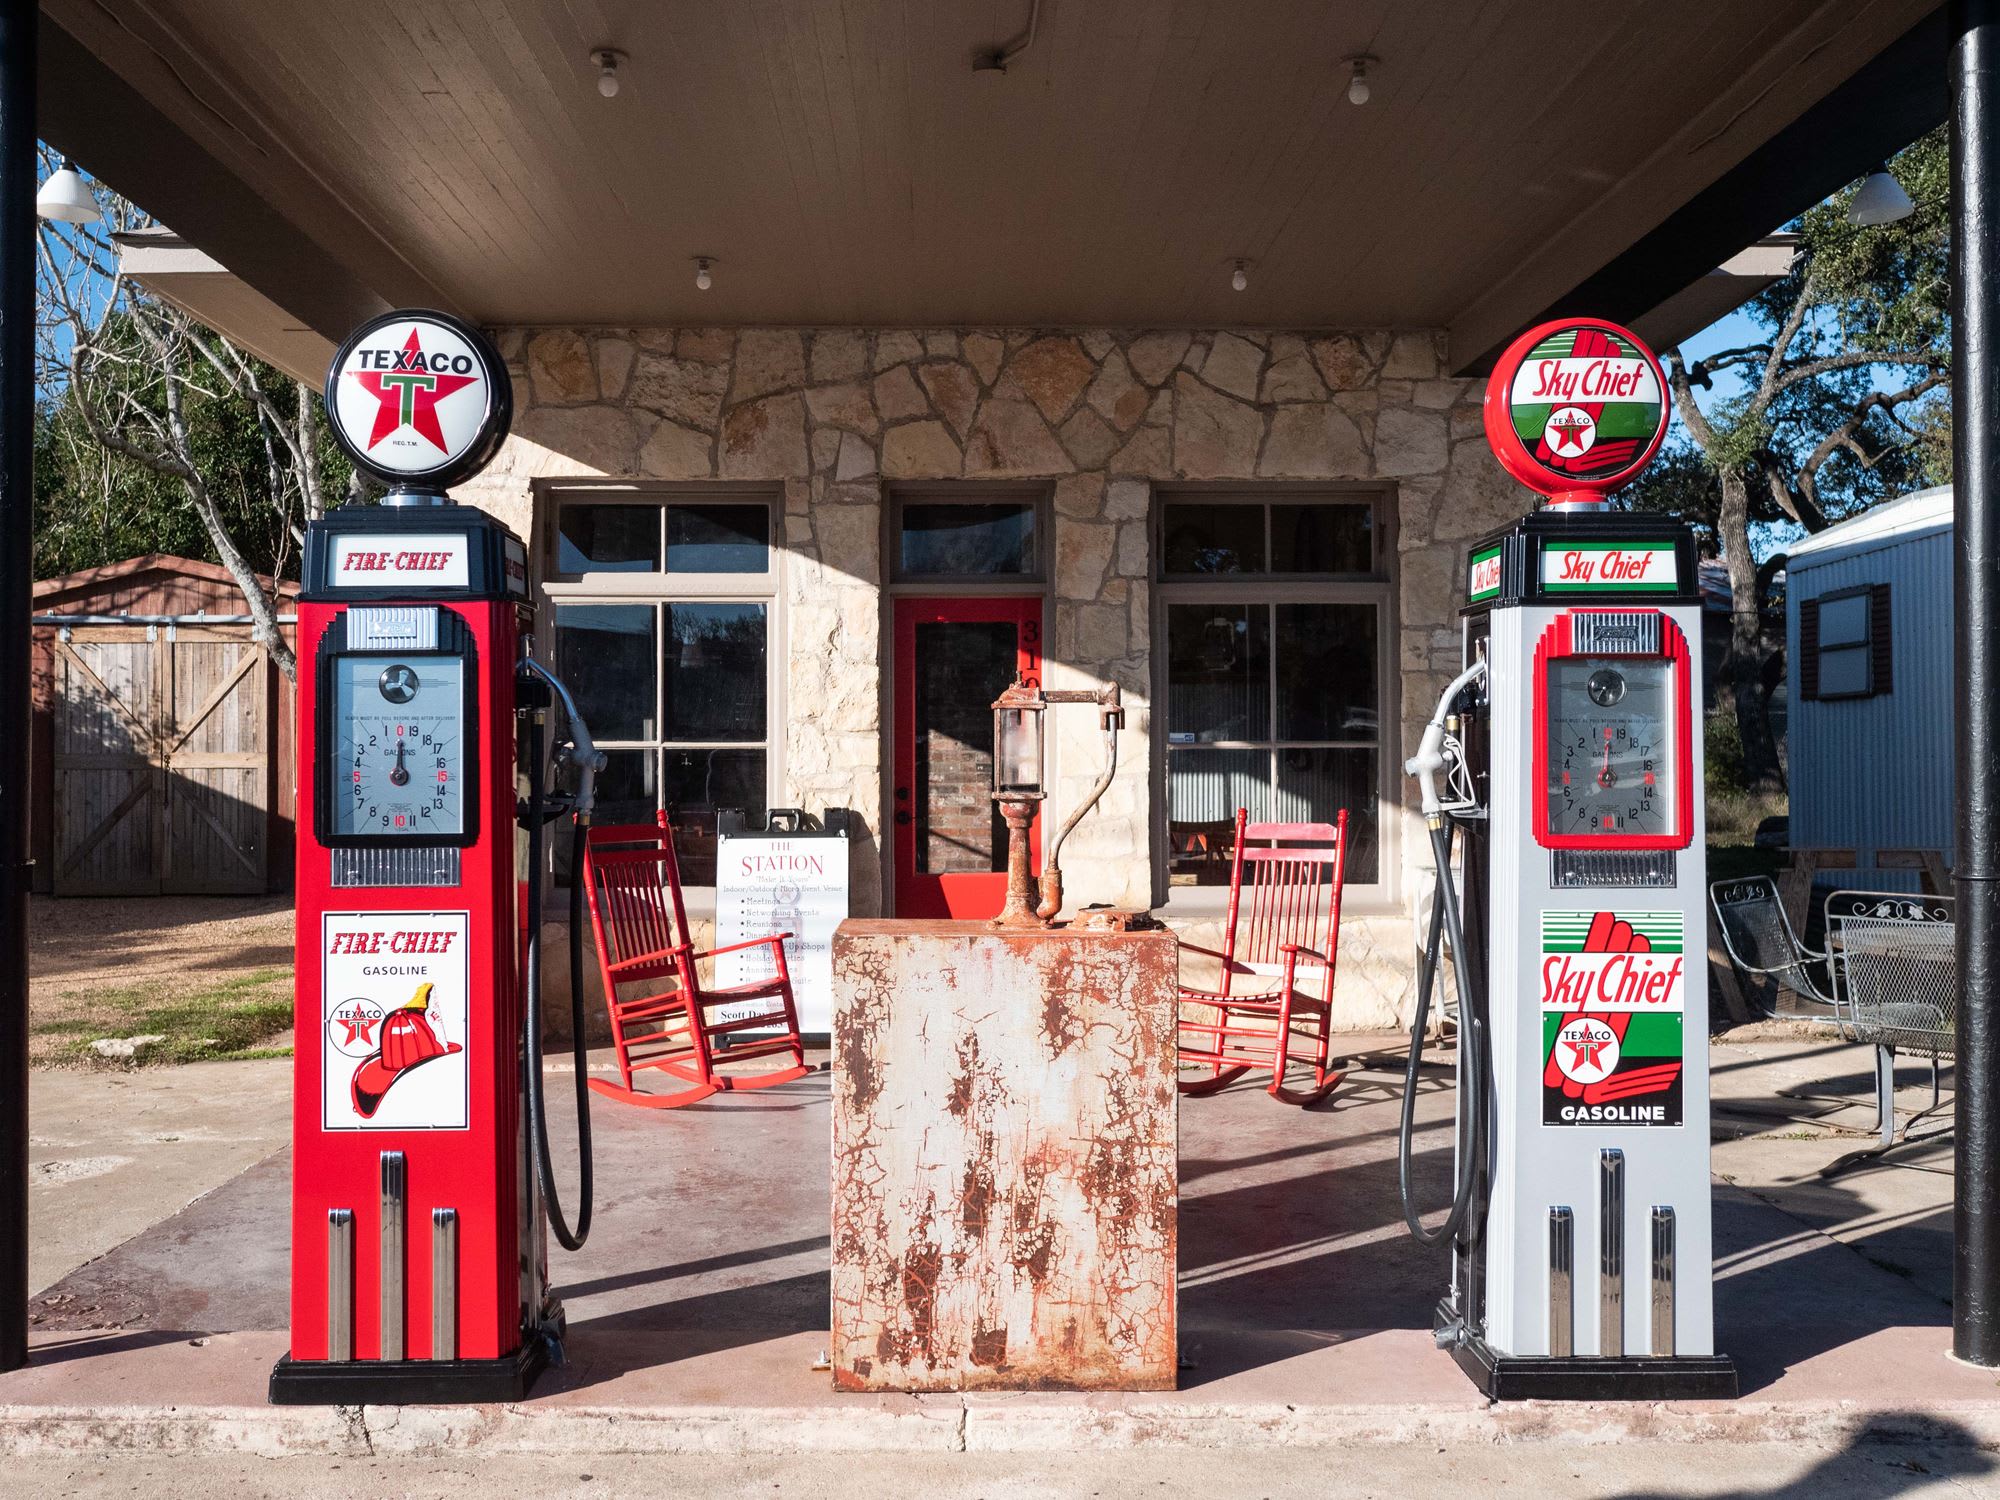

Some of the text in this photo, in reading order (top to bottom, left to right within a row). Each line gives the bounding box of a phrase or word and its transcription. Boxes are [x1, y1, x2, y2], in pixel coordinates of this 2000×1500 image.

[359, 350, 473, 374] TEXACO
[1532, 360, 1645, 400] Sky Chief
[381, 374, 436, 427] T
[1553, 417, 1590, 425] TEXACO
[1560, 425, 1581, 443] T
[343, 552, 453, 571] FIRE-CHIEF
[1559, 551, 1653, 583] Sky Chief
[1486, 559, 1500, 587] Chie
[384, 725, 388, 737] 1
[396, 725, 404, 736] 0
[409, 725, 419, 737] 19
[1593, 727, 1596, 739] 1
[1616, 728, 1626, 739] 19
[369, 735, 377, 746] 2
[422, 734, 432, 746] 18
[1578, 738, 1585, 748] 2
[1629, 737, 1639, 748] 18
[357, 744, 365, 755] 3
[433, 743, 443, 754] 17
[1567, 746, 1574, 757] 3
[1640, 746, 1650, 756] 17
[354, 757, 361, 769] 4
[436, 757, 446, 769] 16
[1564, 759, 1570, 770] 4
[1643, 760, 1653, 771] 16
[353, 771, 360, 782] 5
[437, 771, 448, 782] 15
[354, 785, 361, 796] 6
[436, 785, 446, 796] 14
[1564, 786, 1570, 797] 6
[1644, 787, 1652, 798] 14
[357, 798, 364, 809] 7
[433, 798, 443, 810] 13
[1567, 800, 1573, 810] 7
[1640, 800, 1650, 811] 13
[369, 806, 377, 817] 8
[421, 806, 431, 817] 12
[1579, 807, 1586, 819] 8
[1628, 808, 1638, 819] 12
[382, 815, 389, 826] 9
[394, 815, 405, 826] 10
[409, 815, 416, 826] 11
[1591, 817, 1598, 828] 9
[1617, 817, 1624, 828] 11
[741, 855, 824, 877] STATION
[330, 931, 458, 954] FIRE-CHIEF
[363, 966, 428, 975] GASOLINE
[1542, 954, 1683, 1013] Sky Chief
[338, 1010, 382, 1019] TEXACO
[721, 1010, 745, 1019] Scott
[1564, 1031, 1611, 1040] TEXACO
[1577, 1043, 1598, 1062] T
[1561, 1106, 1665, 1121] GASOLINE
